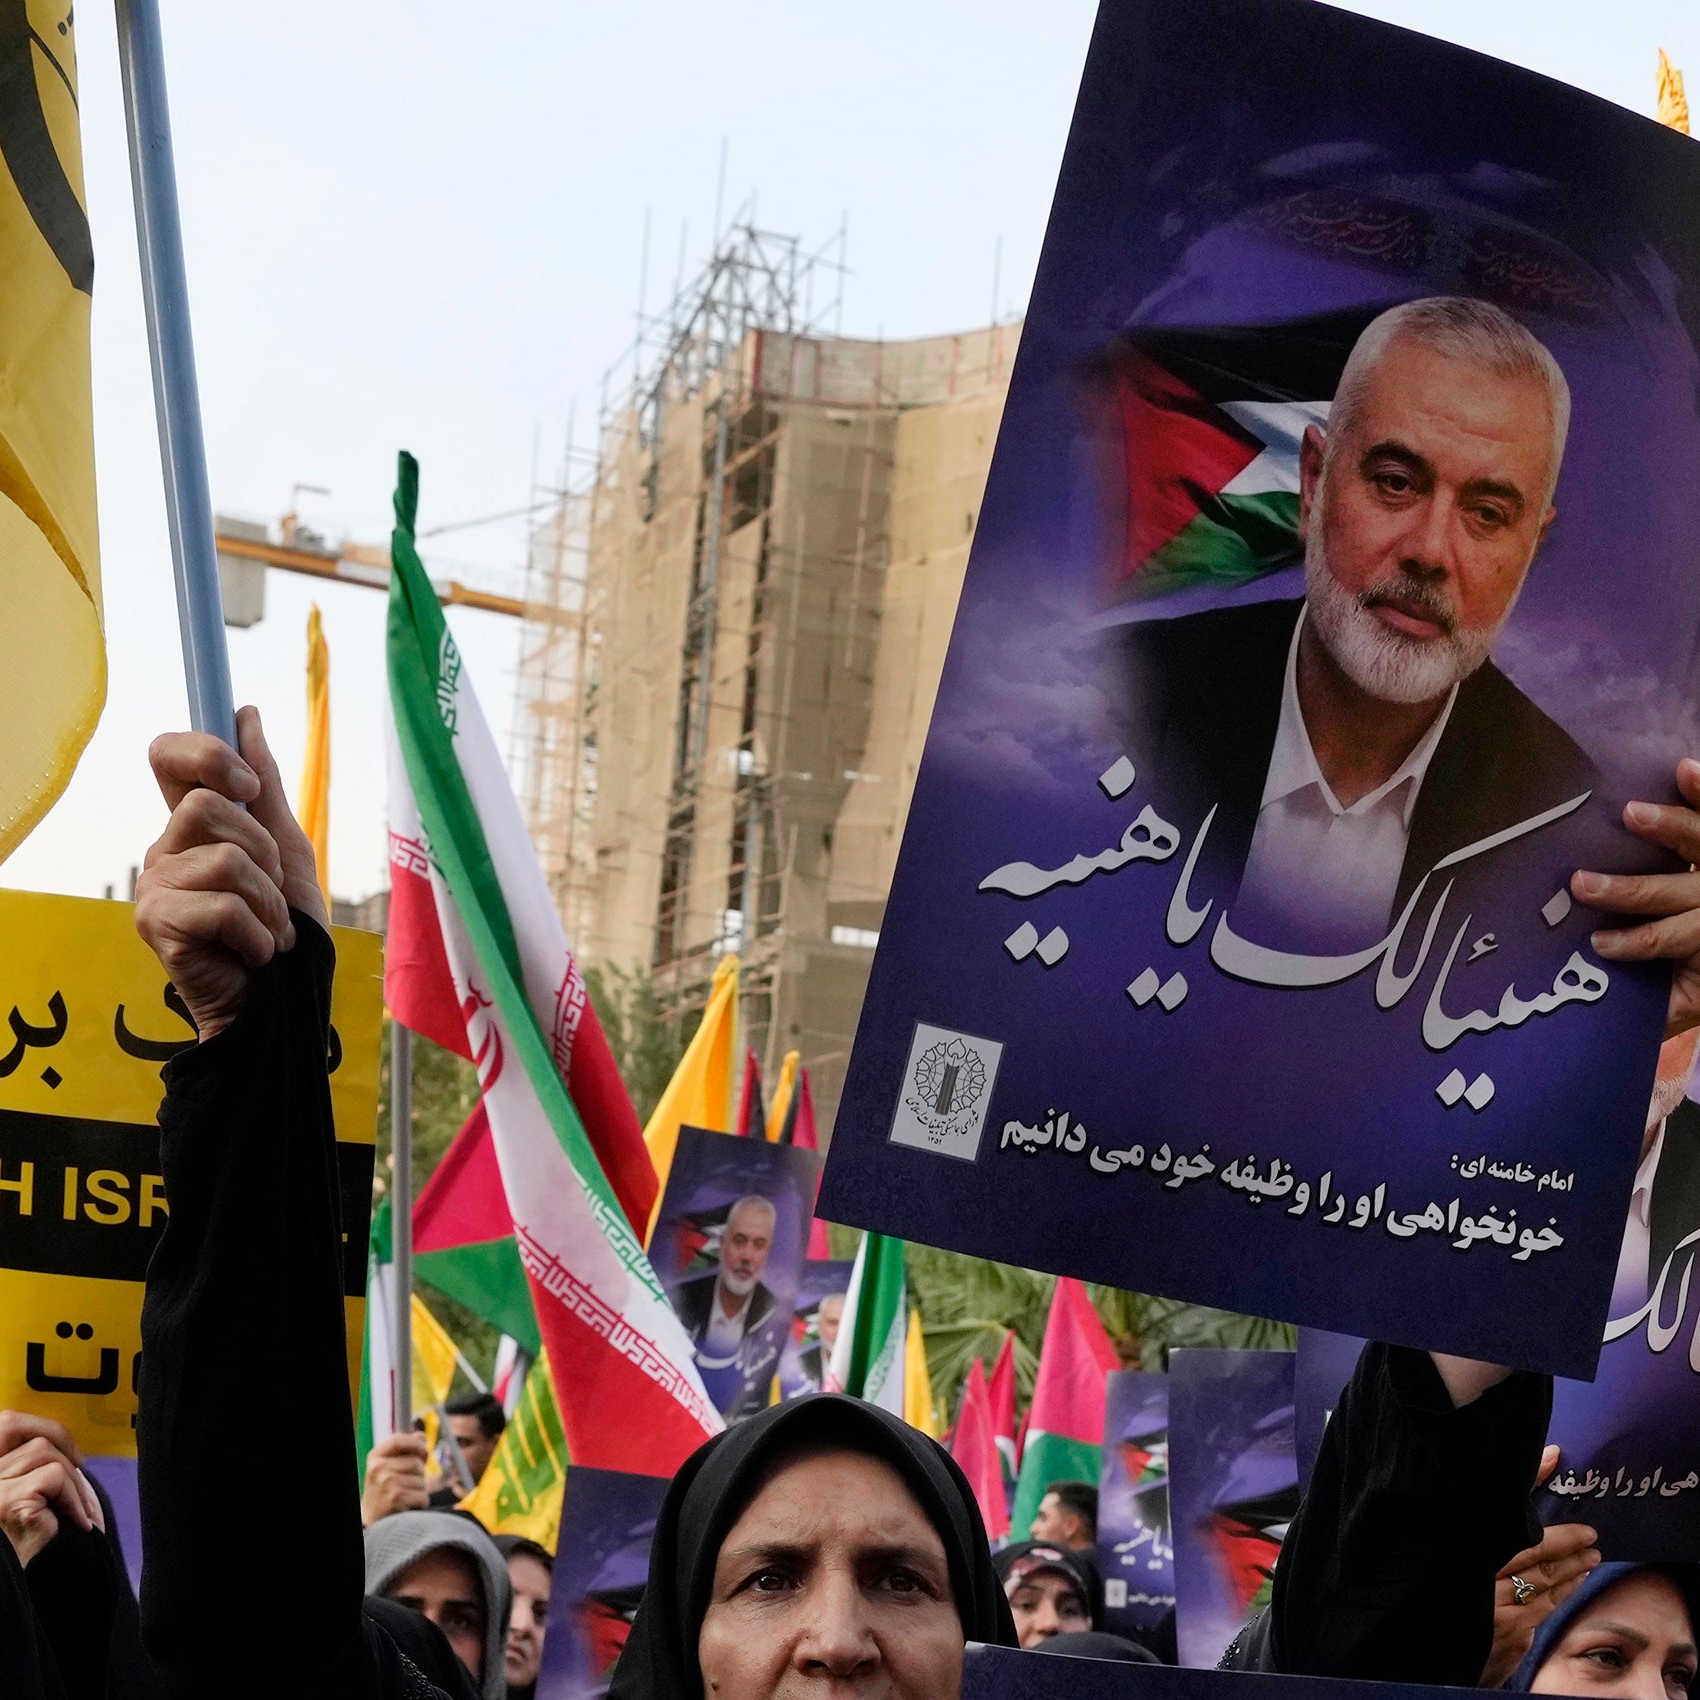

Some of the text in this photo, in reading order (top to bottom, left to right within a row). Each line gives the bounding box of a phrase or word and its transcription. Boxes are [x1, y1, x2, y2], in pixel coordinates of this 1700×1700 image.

[1128, 803, 1218, 1010] یا
[1000, 1108, 1565, 1260] خونخواهی او را وظیفه خود می دانیم
